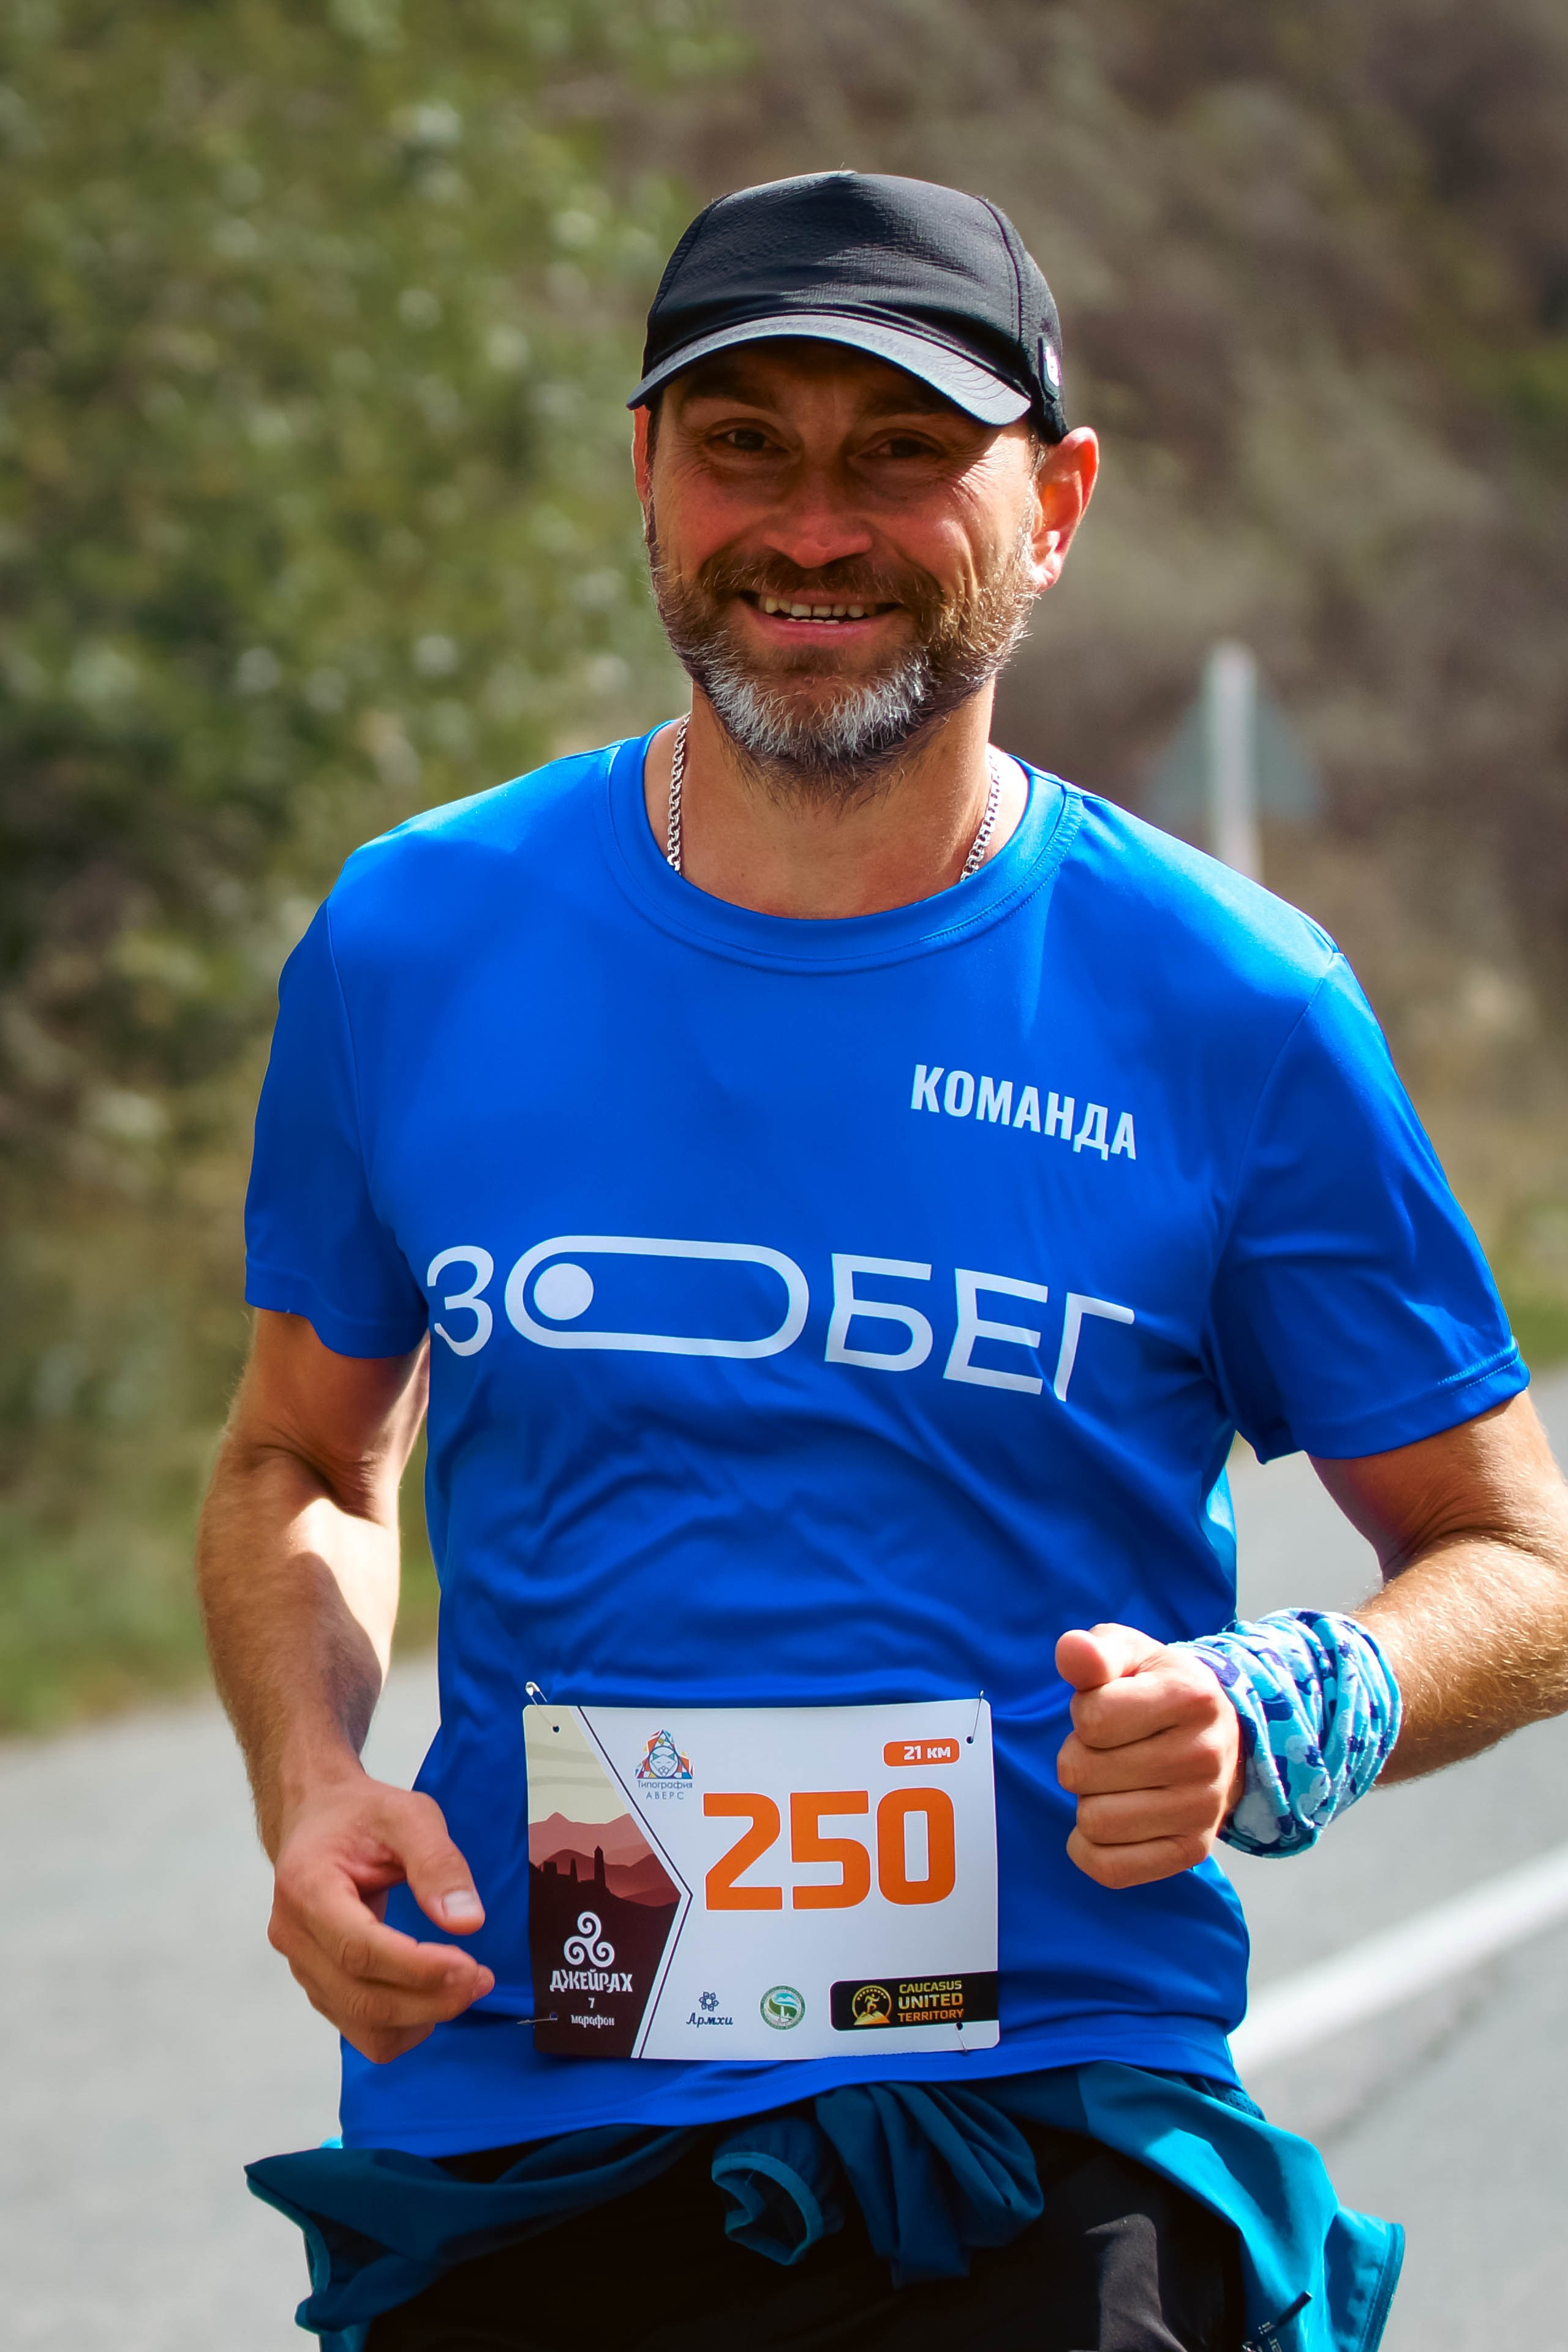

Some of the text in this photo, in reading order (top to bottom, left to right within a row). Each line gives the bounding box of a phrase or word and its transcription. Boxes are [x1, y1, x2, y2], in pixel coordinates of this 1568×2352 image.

[910, 1064, 1137, 1161] КОМАНДА
[903, 1745, 922, 1761] 21
[638, 1780, 693, 1790] Типография
[646, 1791, 685, 1800] АВЕРС
[703, 1787, 957, 1911] 250
[549, 1969, 633, 1994] ДЖЕЙРАХ
[899, 1980, 962, 1994] CAUCASUS
[587, 1997, 595, 2009] 7
[898, 1992, 963, 2010] UNITED
[570, 2014, 615, 2029] марафон
[685, 2012, 734, 2029] Армхи
[897, 2008, 965, 2023] TERRITORY
